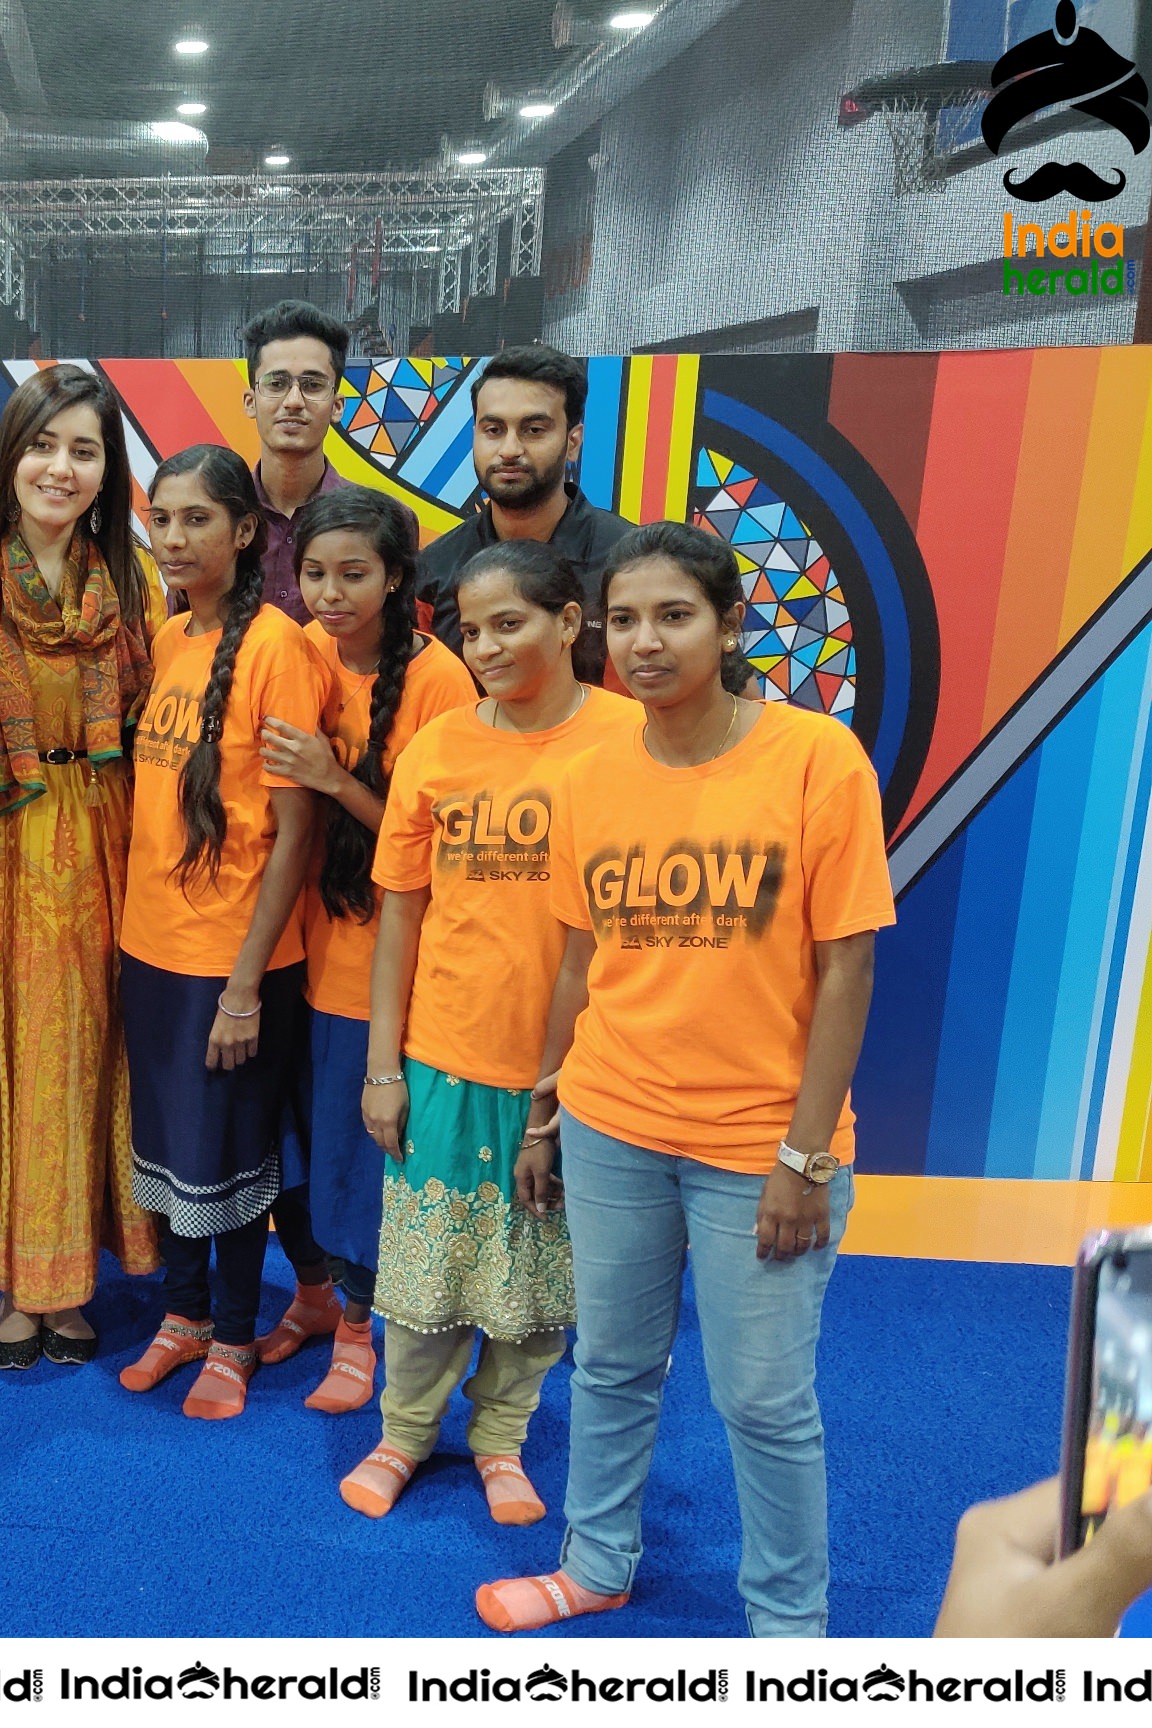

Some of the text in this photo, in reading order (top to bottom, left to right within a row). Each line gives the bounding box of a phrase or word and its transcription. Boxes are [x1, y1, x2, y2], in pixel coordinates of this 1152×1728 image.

[138, 693, 203, 744] LOW
[155, 758, 179, 771] ZOE
[440, 799, 550, 845] GLO
[447, 851, 473, 862] we're
[476, 850, 530, 862] different
[489, 870, 551, 882] SKY ZO
[591, 853, 768, 910] GLOW
[630, 913, 679, 926] different
[716, 913, 748, 927] dark
[645, 936, 729, 949] SKY ZONE
